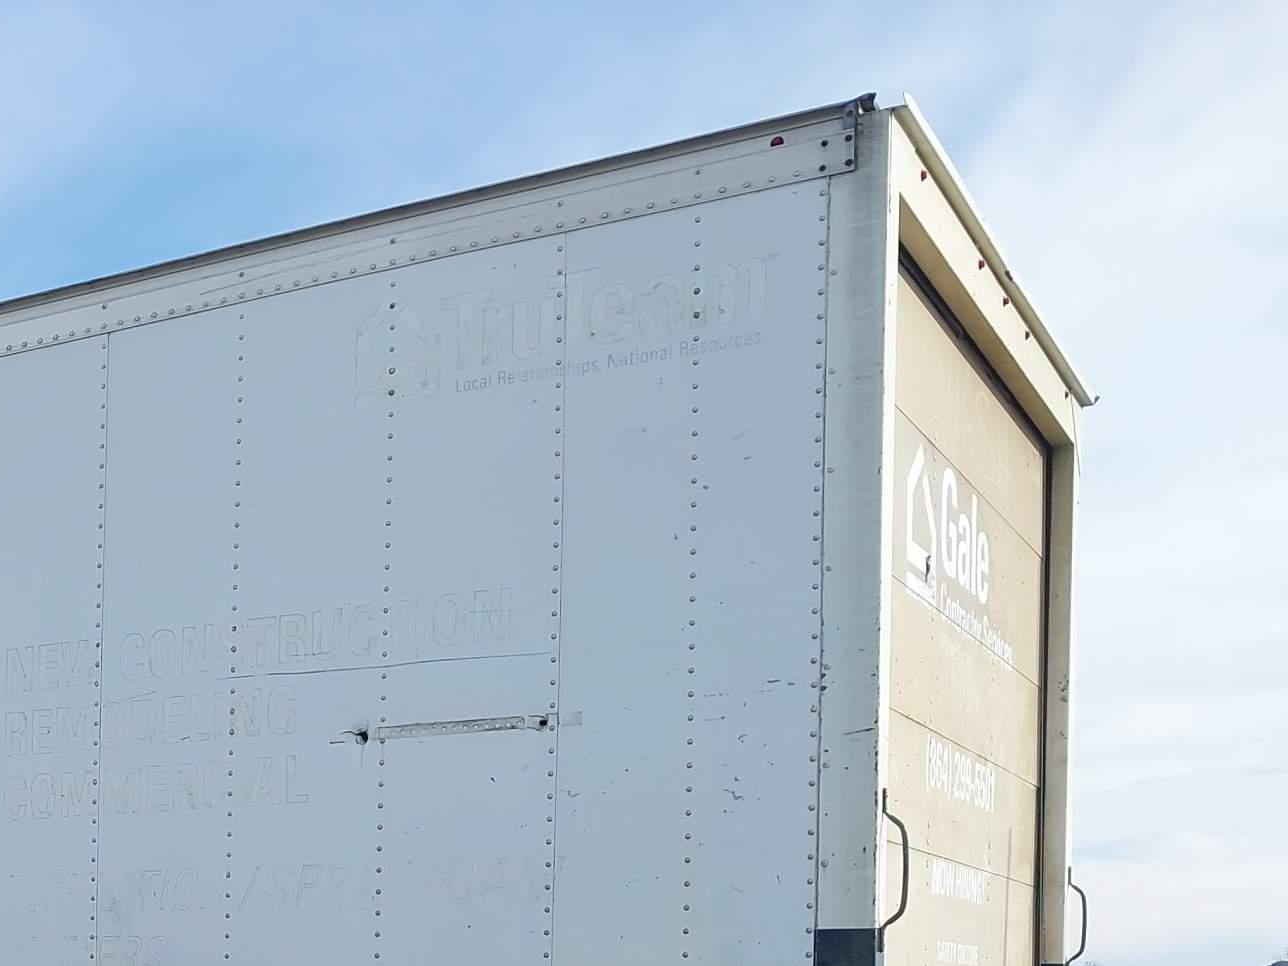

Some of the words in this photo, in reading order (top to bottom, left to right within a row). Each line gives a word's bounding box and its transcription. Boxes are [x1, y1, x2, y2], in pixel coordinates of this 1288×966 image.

[455, 374, 494, 393] Local
[606, 346, 673, 369] National
[678, 330, 763, 357] Resources
[941, 466, 990, 605] Gale
[940, 581, 982, 645] Contractor
[983, 614, 1013, 672] Services
[2, 753, 311, 823] COMMERCAL
[926, 734, 952, 801] (864)
[952, 751, 996, 814] 299-5501
[932, 857, 955, 897] NOW
